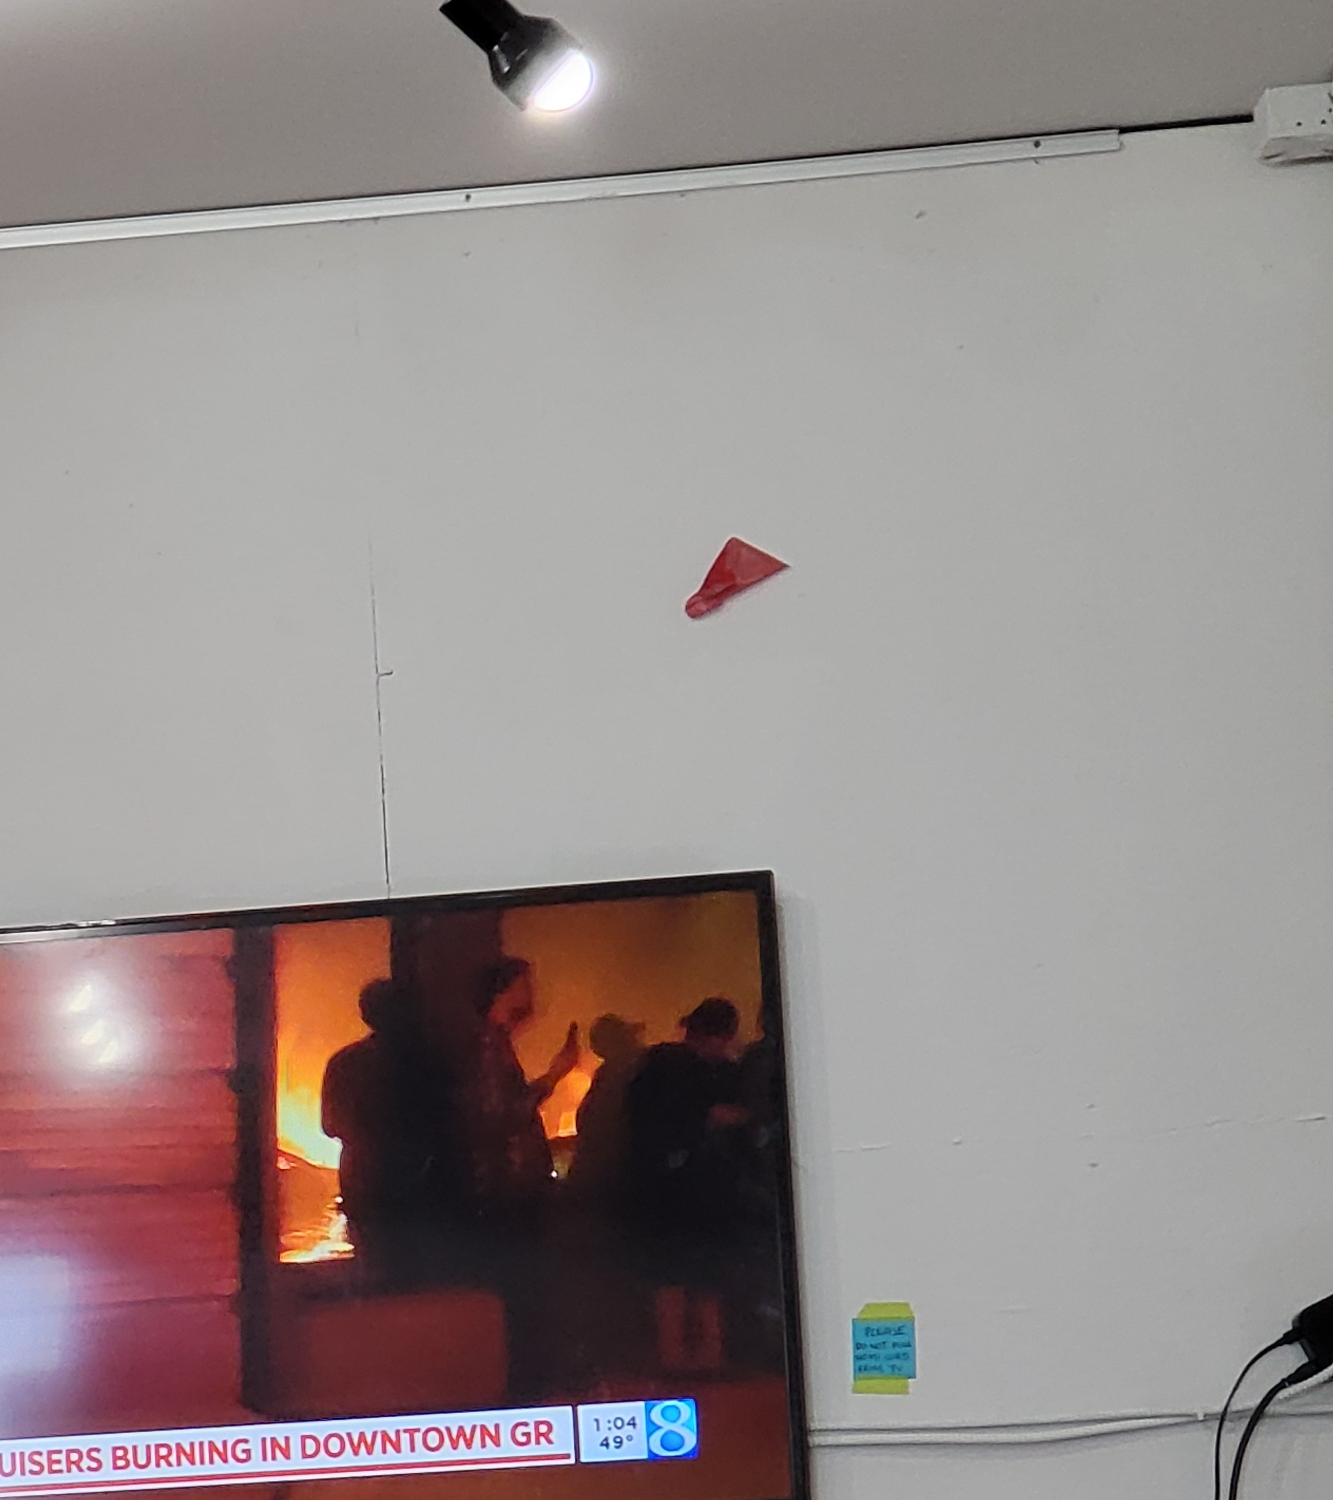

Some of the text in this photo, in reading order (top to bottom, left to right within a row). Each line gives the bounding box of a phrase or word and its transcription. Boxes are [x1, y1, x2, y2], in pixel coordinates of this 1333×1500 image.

[593, 1415, 638, 1432] 1:04
[648, 1399, 696, 1458] 8
[111, 1438, 252, 1471] BURNING
[261, 1435, 291, 1461] IN
[300, 1423, 501, 1459] DOWNTOWN
[510, 1420, 554, 1447] GR
[599, 1434, 634, 1450] 49°
